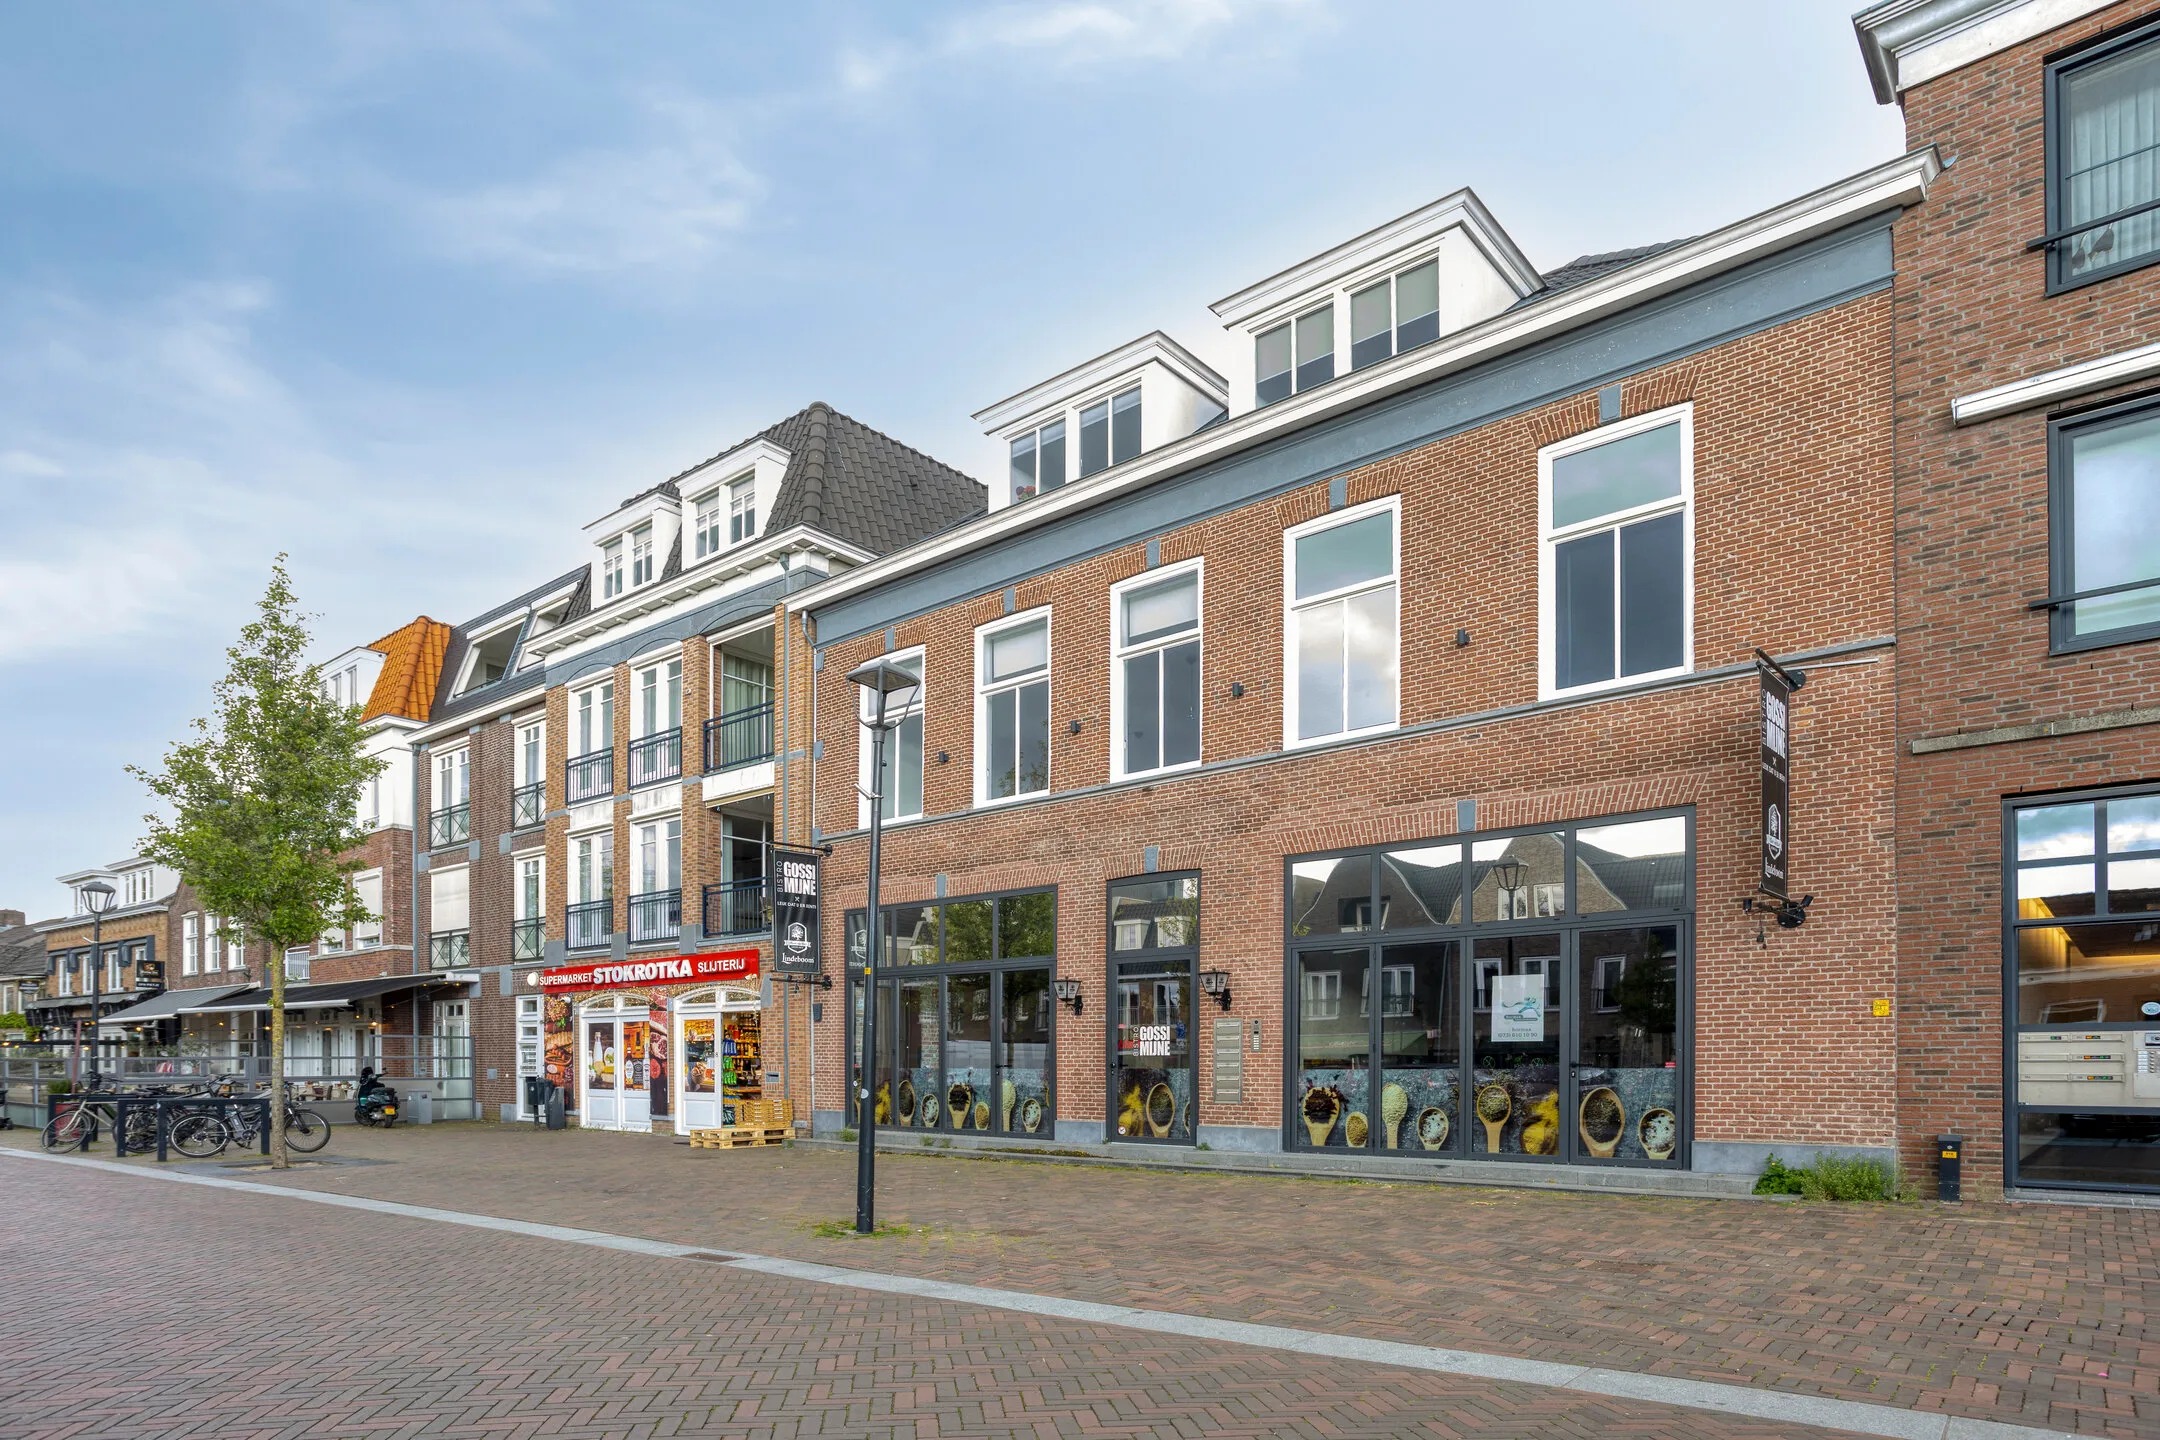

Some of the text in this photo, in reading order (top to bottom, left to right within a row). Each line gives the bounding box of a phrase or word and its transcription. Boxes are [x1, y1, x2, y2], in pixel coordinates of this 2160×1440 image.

[1766, 691, 1786, 732] GOSSI
[783, 861, 816, 880] GOSSI
[784, 877, 816, 896] MIJNE
[782, 952, 815, 964] Lindeboom
[539, 958, 745, 986] SUPERMARKET STOKROTKA SLIJTERIJ
[1140, 1026, 1170, 1040] GOSSI
[1140, 1041, 1170, 1056] MIJNE
